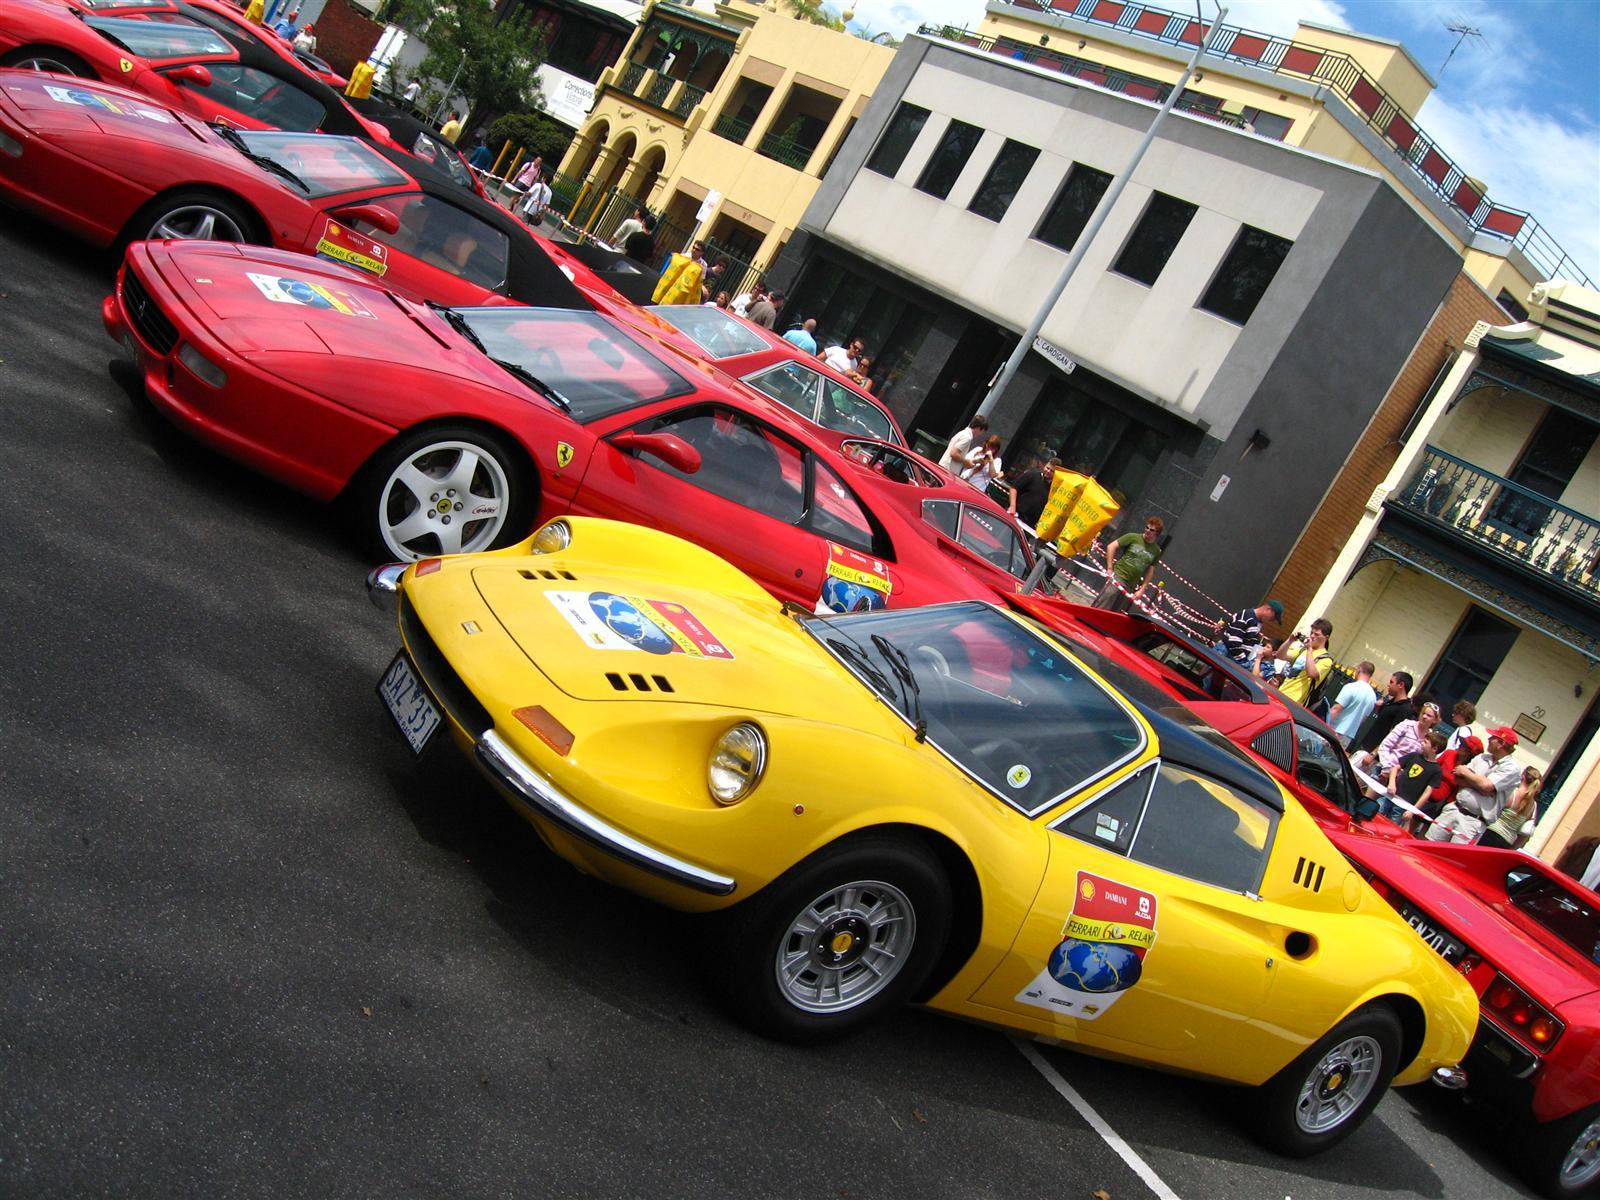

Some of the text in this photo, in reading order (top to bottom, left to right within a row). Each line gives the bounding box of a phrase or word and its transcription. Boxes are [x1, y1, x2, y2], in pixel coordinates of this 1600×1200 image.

[564, 80, 593, 99] Corrections
[320, 242, 385, 272] FERRARI RELAY
[1041, 342, 1068, 366] CARDIGAN
[829, 565, 853, 577] FERRARI
[386, 661, 439, 745] SAZ 351
[1531, 705, 1546, 720] 29
[1104, 891, 1128, 906] DAMIANI
[1067, 920, 1102, 937] FERRARI
[1128, 929, 1154, 944] RELAY
